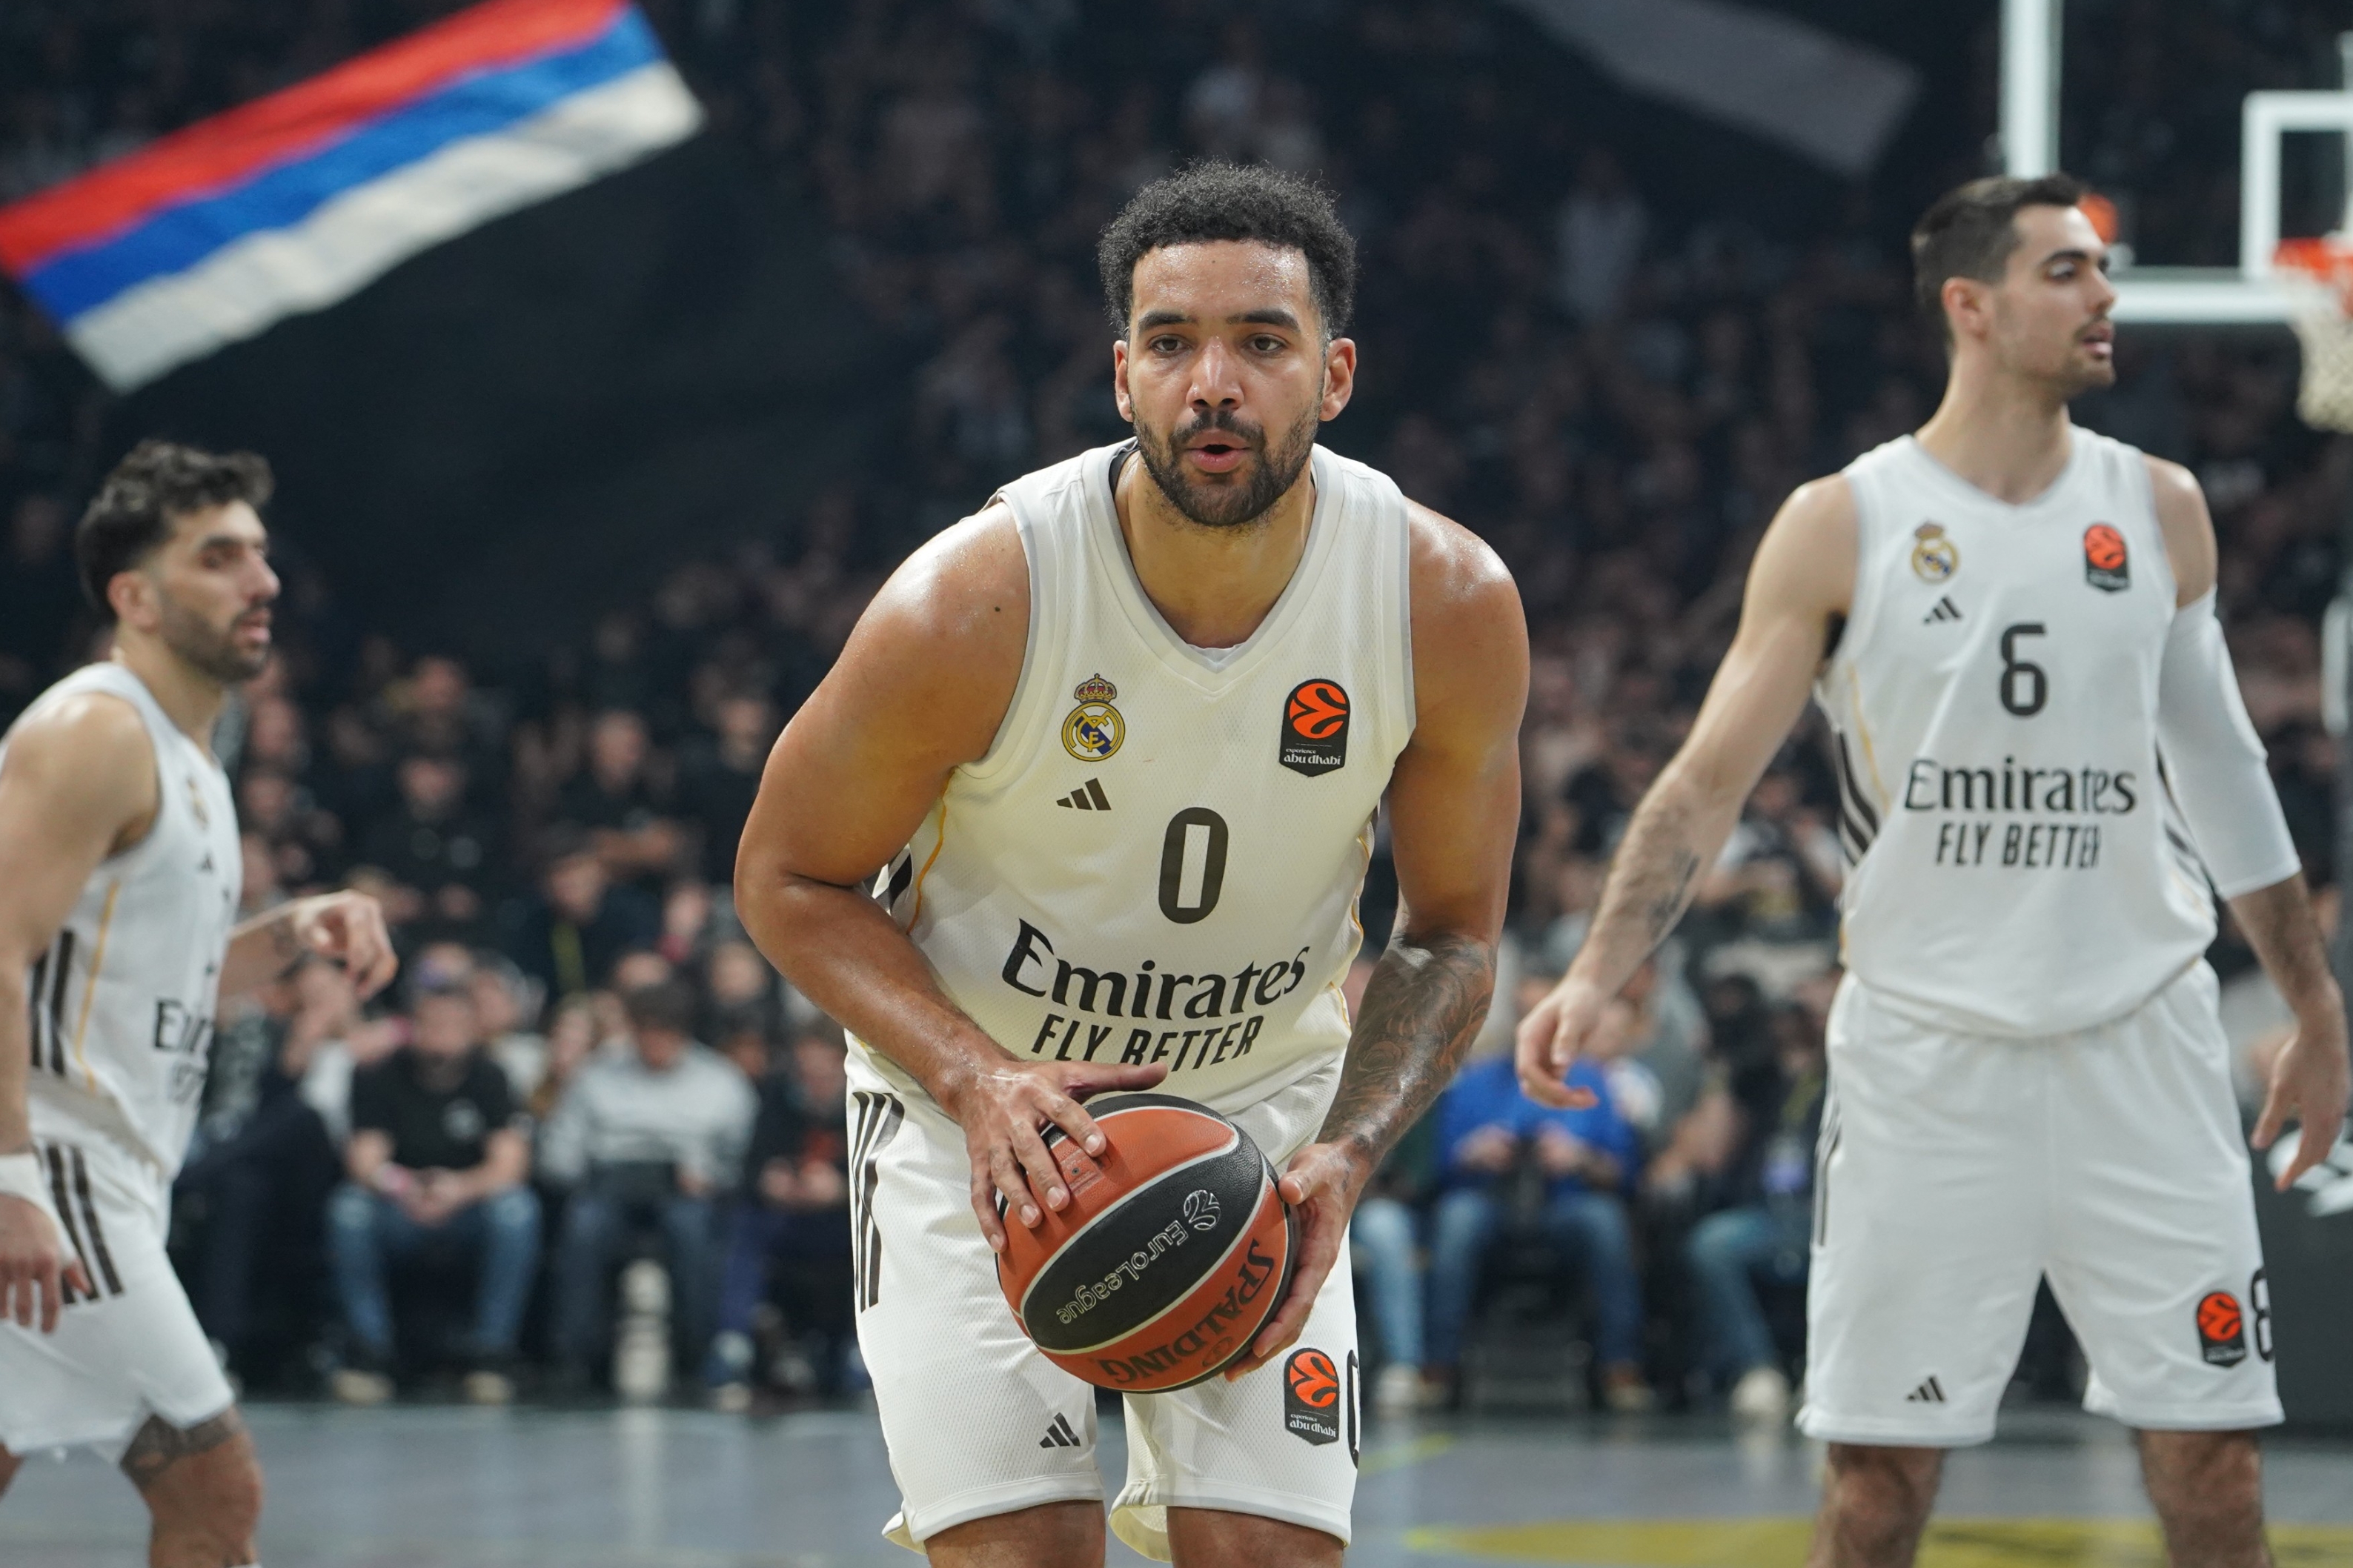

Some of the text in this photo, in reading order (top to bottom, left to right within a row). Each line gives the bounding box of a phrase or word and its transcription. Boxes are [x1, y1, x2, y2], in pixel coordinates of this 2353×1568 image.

[1999, 622, 2048, 718] 6
[1284, 754, 1341, 765] abu dhabi
[1905, 754, 2136, 814] Emirates
[1158, 807, 1229, 924] 0
[1937, 821, 2102, 868] FLY BETTER
[1002, 918, 1311, 1021] Emirates
[1031, 1014, 1264, 1072] FLY BETTER
[1056, 1220, 1189, 1324] EuroLeague
[1097, 1238, 1275, 1384] SPALDING
[1290, 1414, 1318, 1422] experience
[1290, 1420, 1336, 1438] abu dhabi
